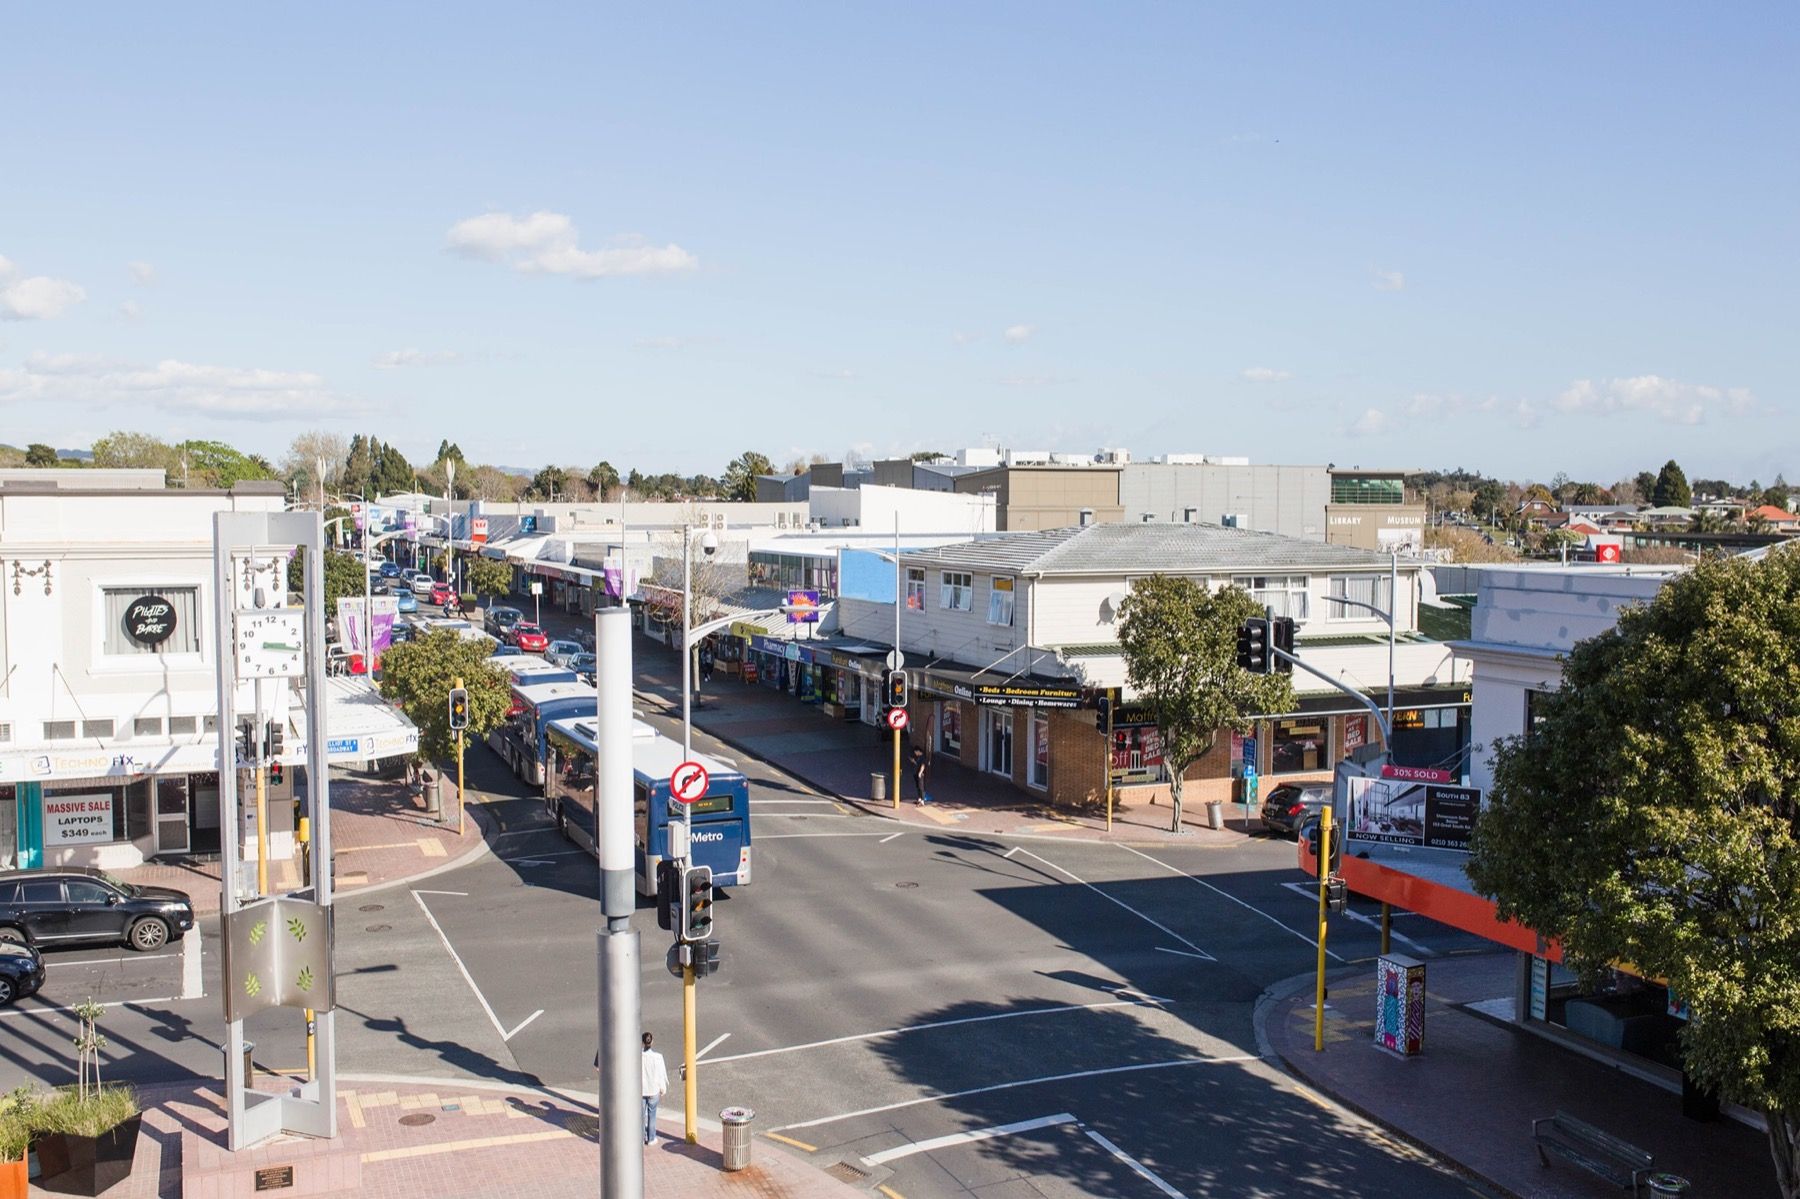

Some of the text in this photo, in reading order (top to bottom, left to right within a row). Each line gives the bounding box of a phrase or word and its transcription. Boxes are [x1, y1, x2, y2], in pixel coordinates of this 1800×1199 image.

[252, 620, 262, 628] 11
[265, 616, 277, 624] 12
[282, 619, 286, 627] 1
[243, 630, 255, 638] 10
[291, 627, 297, 636] 2
[240, 642, 246, 650] 9
[296, 641, 302, 649] 3
[763, 638, 786, 658] Pharmacy
[244, 655, 251, 663] 8
[255, 663, 261, 672] 7
[268, 667, 275, 675] 6
[282, 663, 288, 671] 5
[954, 684, 973, 697] Online
[1005, 687, 1038, 695] Bedroom
[1040, 688, 1077, 697] Furniture
[1463, 692, 1472, 702] Fu
[982, 697, 1077, 708] Lounge Dining Homewares
[1126, 711, 1158, 722] Mattre
[54, 756, 109, 770] TECHNO
[1393, 767, 1438, 780] 30% SOLD
[46, 800, 111, 814] MASSIVE SALE
[58, 815, 103, 826] LAPTOPS
[61, 828, 89, 839] $349
[692, 831, 724, 843] Metro
[1355, 833, 1415, 845] NOW SELLING
